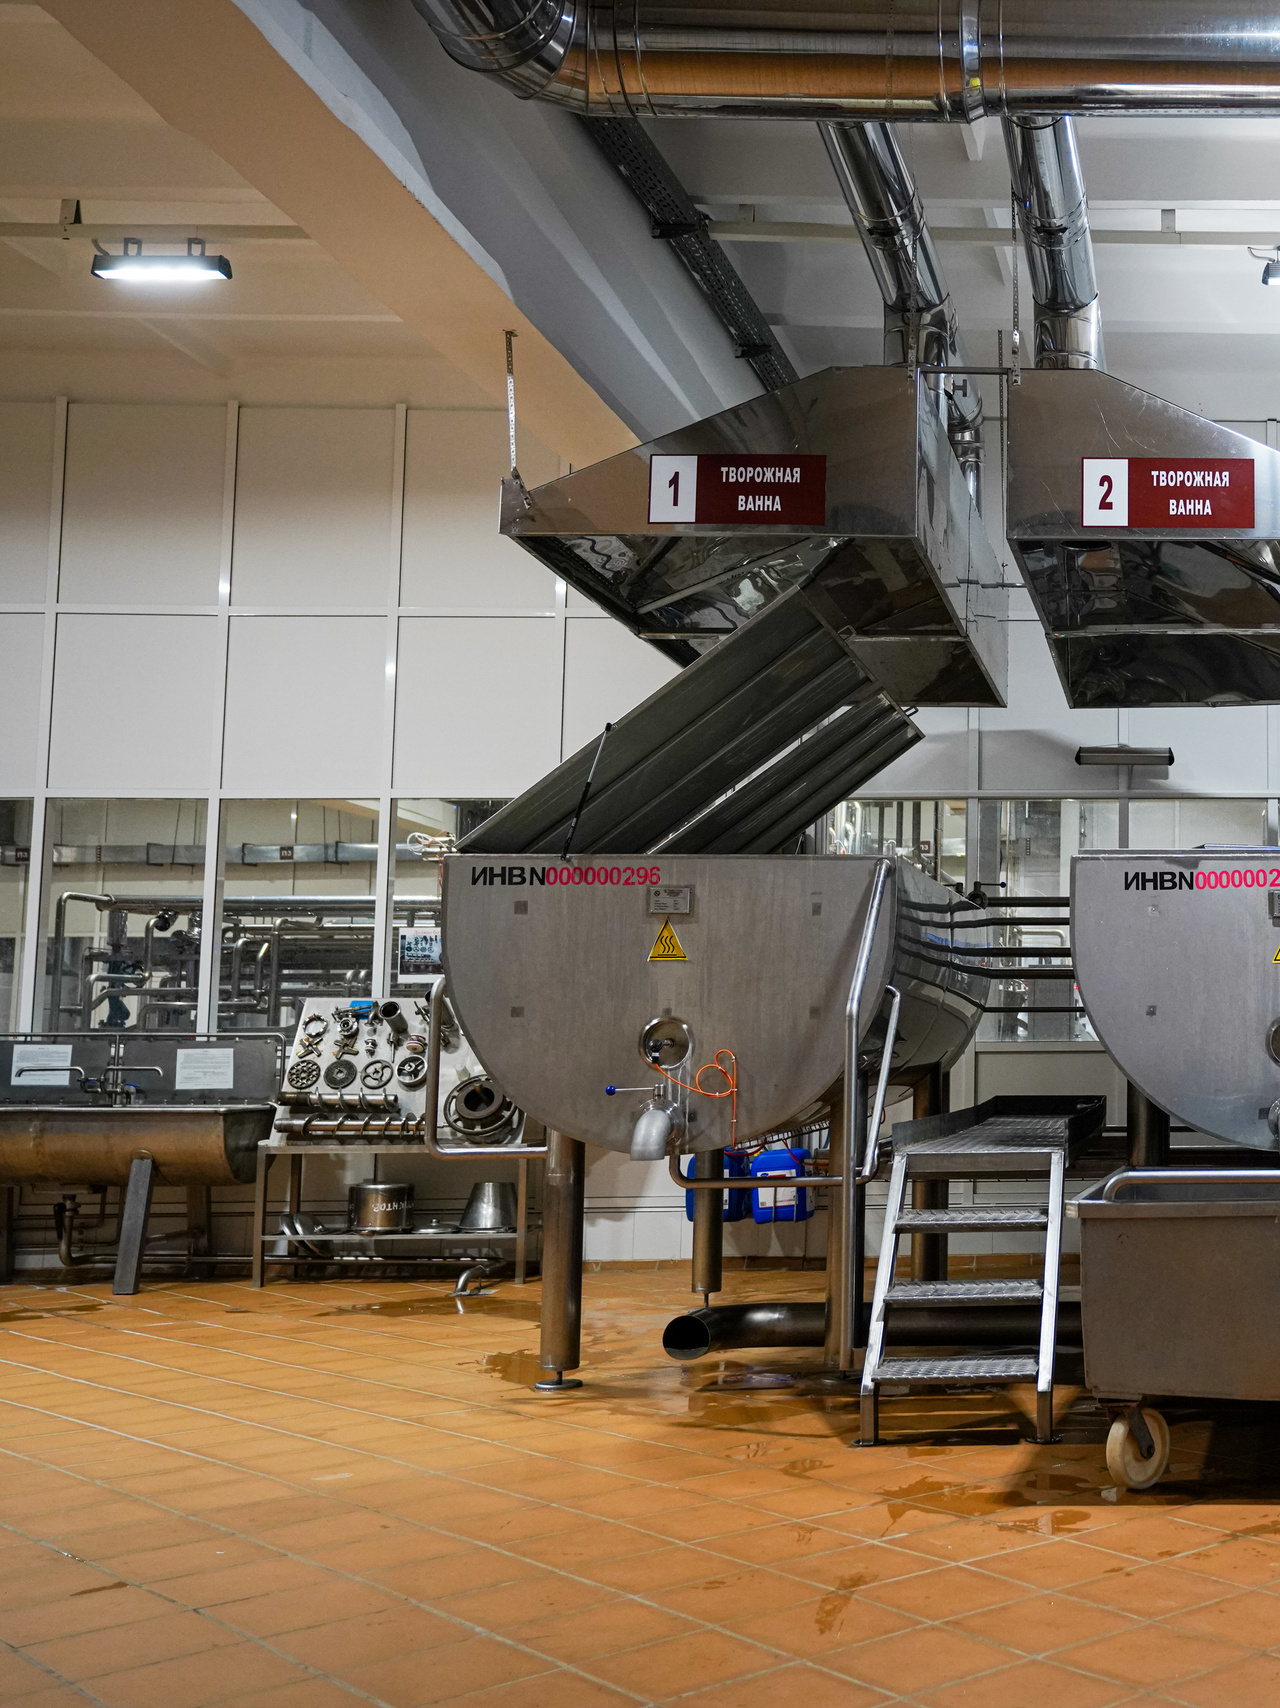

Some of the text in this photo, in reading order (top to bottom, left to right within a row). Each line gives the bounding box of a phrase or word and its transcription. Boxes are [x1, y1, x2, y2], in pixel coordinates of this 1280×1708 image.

[720, 466, 801, 483] ТВОРОЖНАЯ
[1150, 470, 1230, 488] ТВОРОЖНАЯ
[668, 471, 680, 507] 1
[1098, 474, 1113, 511] 2
[737, 495, 782, 512] ВАННА
[1169, 498, 1213, 516] ВАННА
